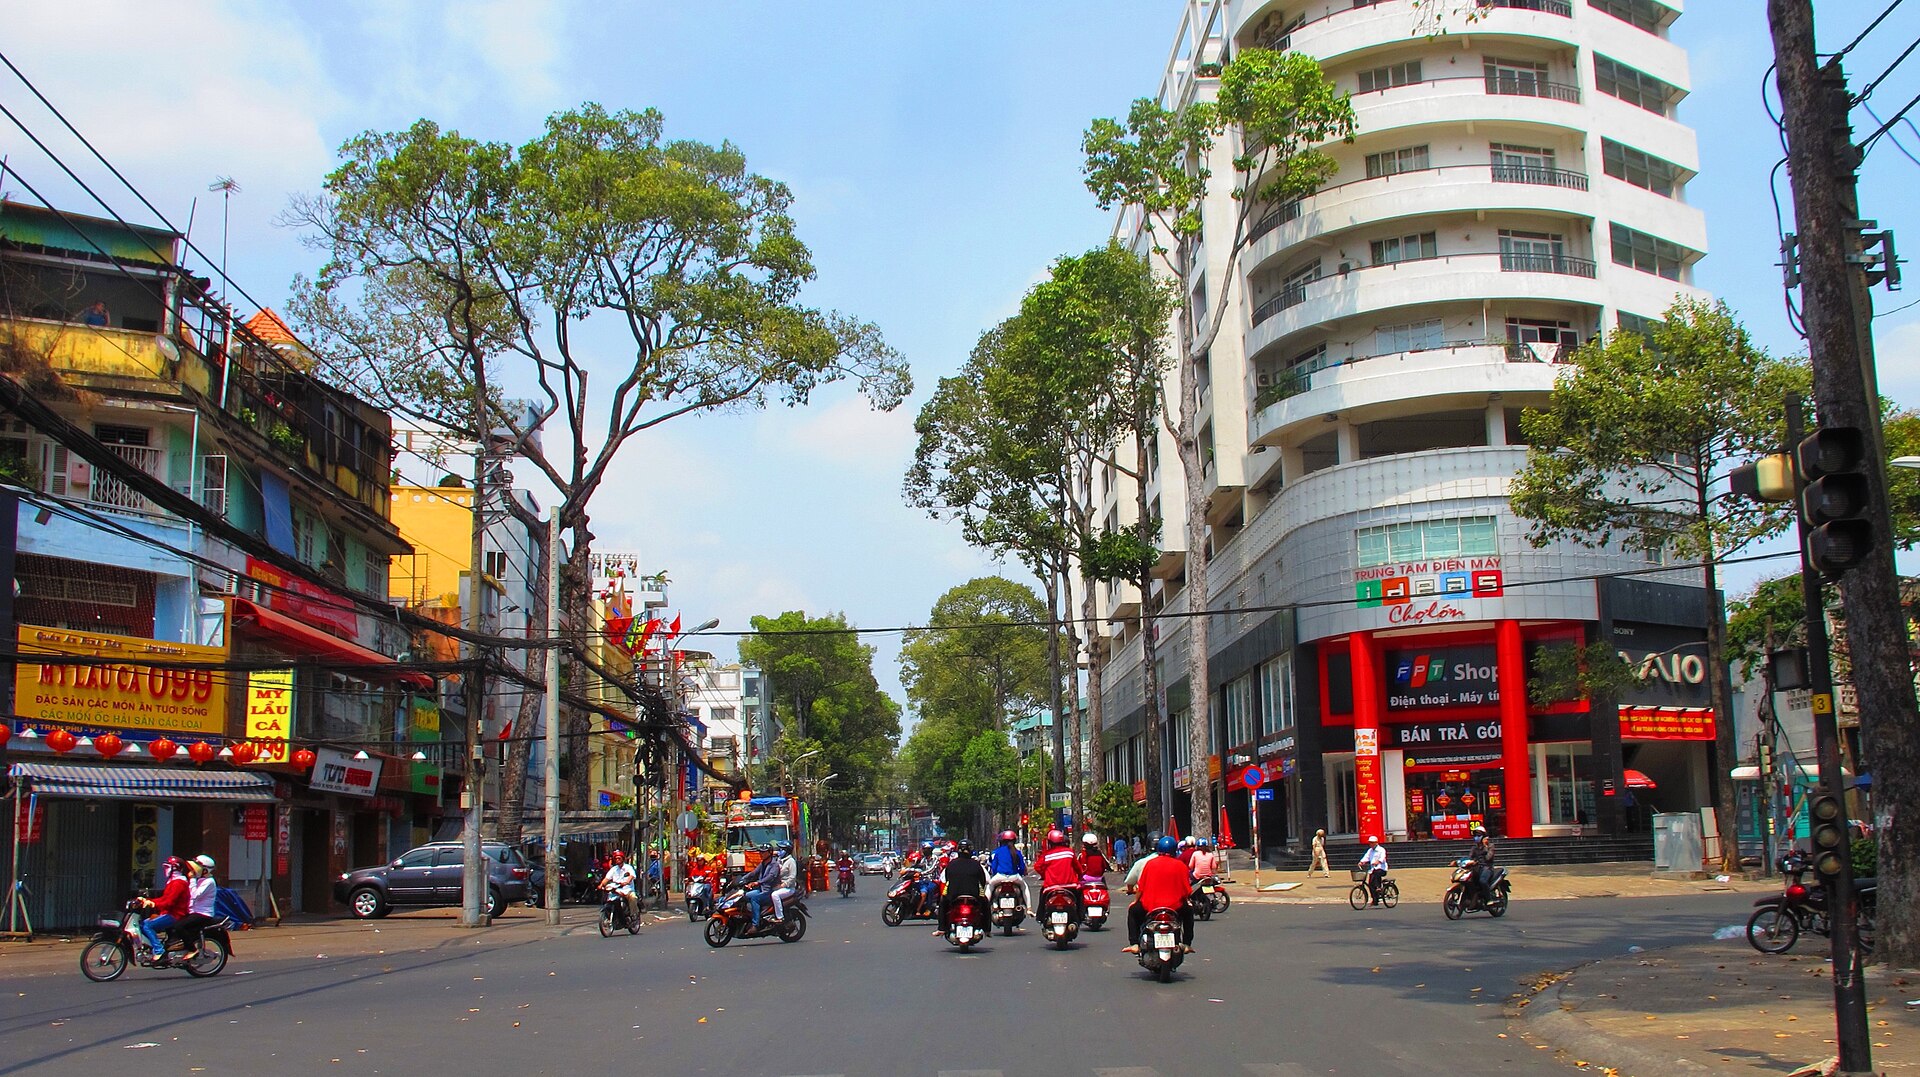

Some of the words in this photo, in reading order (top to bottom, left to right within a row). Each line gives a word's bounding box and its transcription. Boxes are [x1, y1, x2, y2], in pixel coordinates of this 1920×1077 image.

[1355, 567, 1395, 580] TRUNG
[1400, 562, 1428, 575] TÂM
[1432, 558, 1466, 572] ĐIỆN
[1470, 556, 1501, 569] MÁY
[1613, 627, 1635, 636] SONY
[147, 666, 212, 704] 099
[1390, 696, 1416, 709] Điện
[1420, 692, 1449, 706] thoại
[1460, 690, 1484, 704] Máy
[1816, 698, 1825, 711] 3
[255, 719, 282, 731] CÁ
[1400, 725, 1431, 742] BÁN
